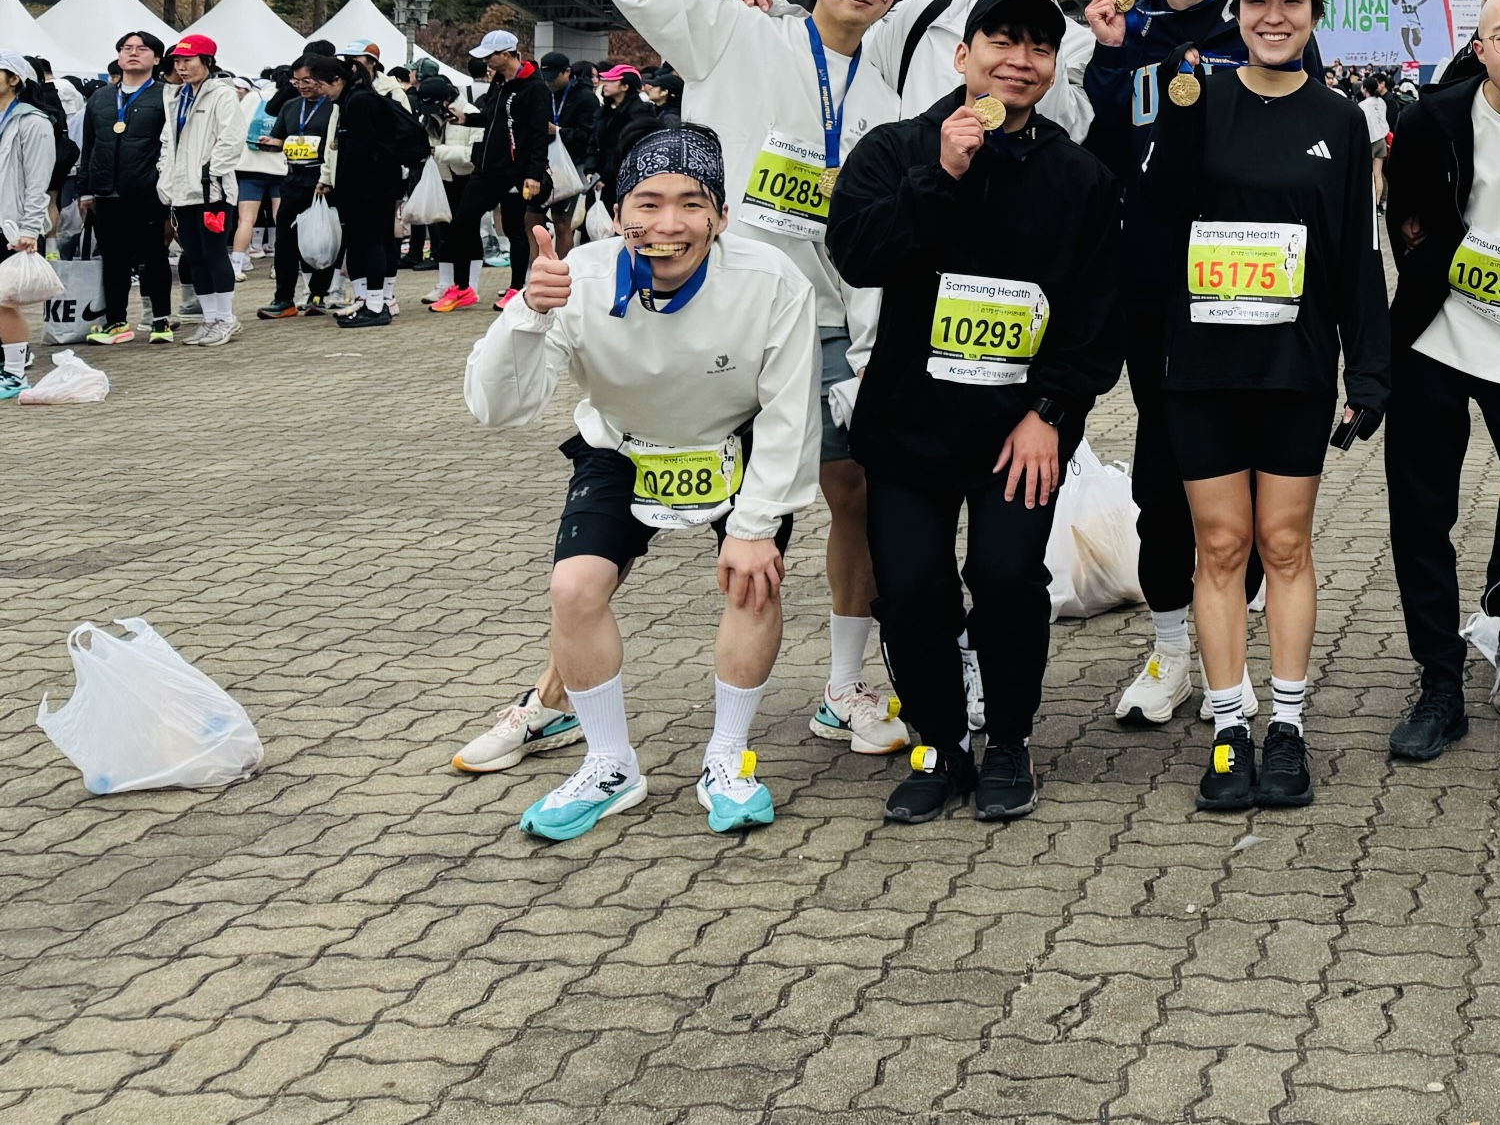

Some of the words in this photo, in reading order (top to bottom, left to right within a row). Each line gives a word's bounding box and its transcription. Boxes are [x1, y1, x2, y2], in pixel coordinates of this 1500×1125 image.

[768, 137, 807, 158] Samsung
[808, 151, 826, 162] Hea
[758, 168, 823, 208] 10285
[1196, 229, 1245, 241] Samsung
[1246, 230, 1280, 240] Health
[1194, 261, 1276, 290] 15175
[945, 281, 996, 297] Samsung
[997, 287, 1031, 299] Health
[1208, 308, 1234, 317] KSPO
[940, 316, 1023, 350] 10293
[949, 366, 976, 376] KSPO
[644, 468, 712, 497] 0288
